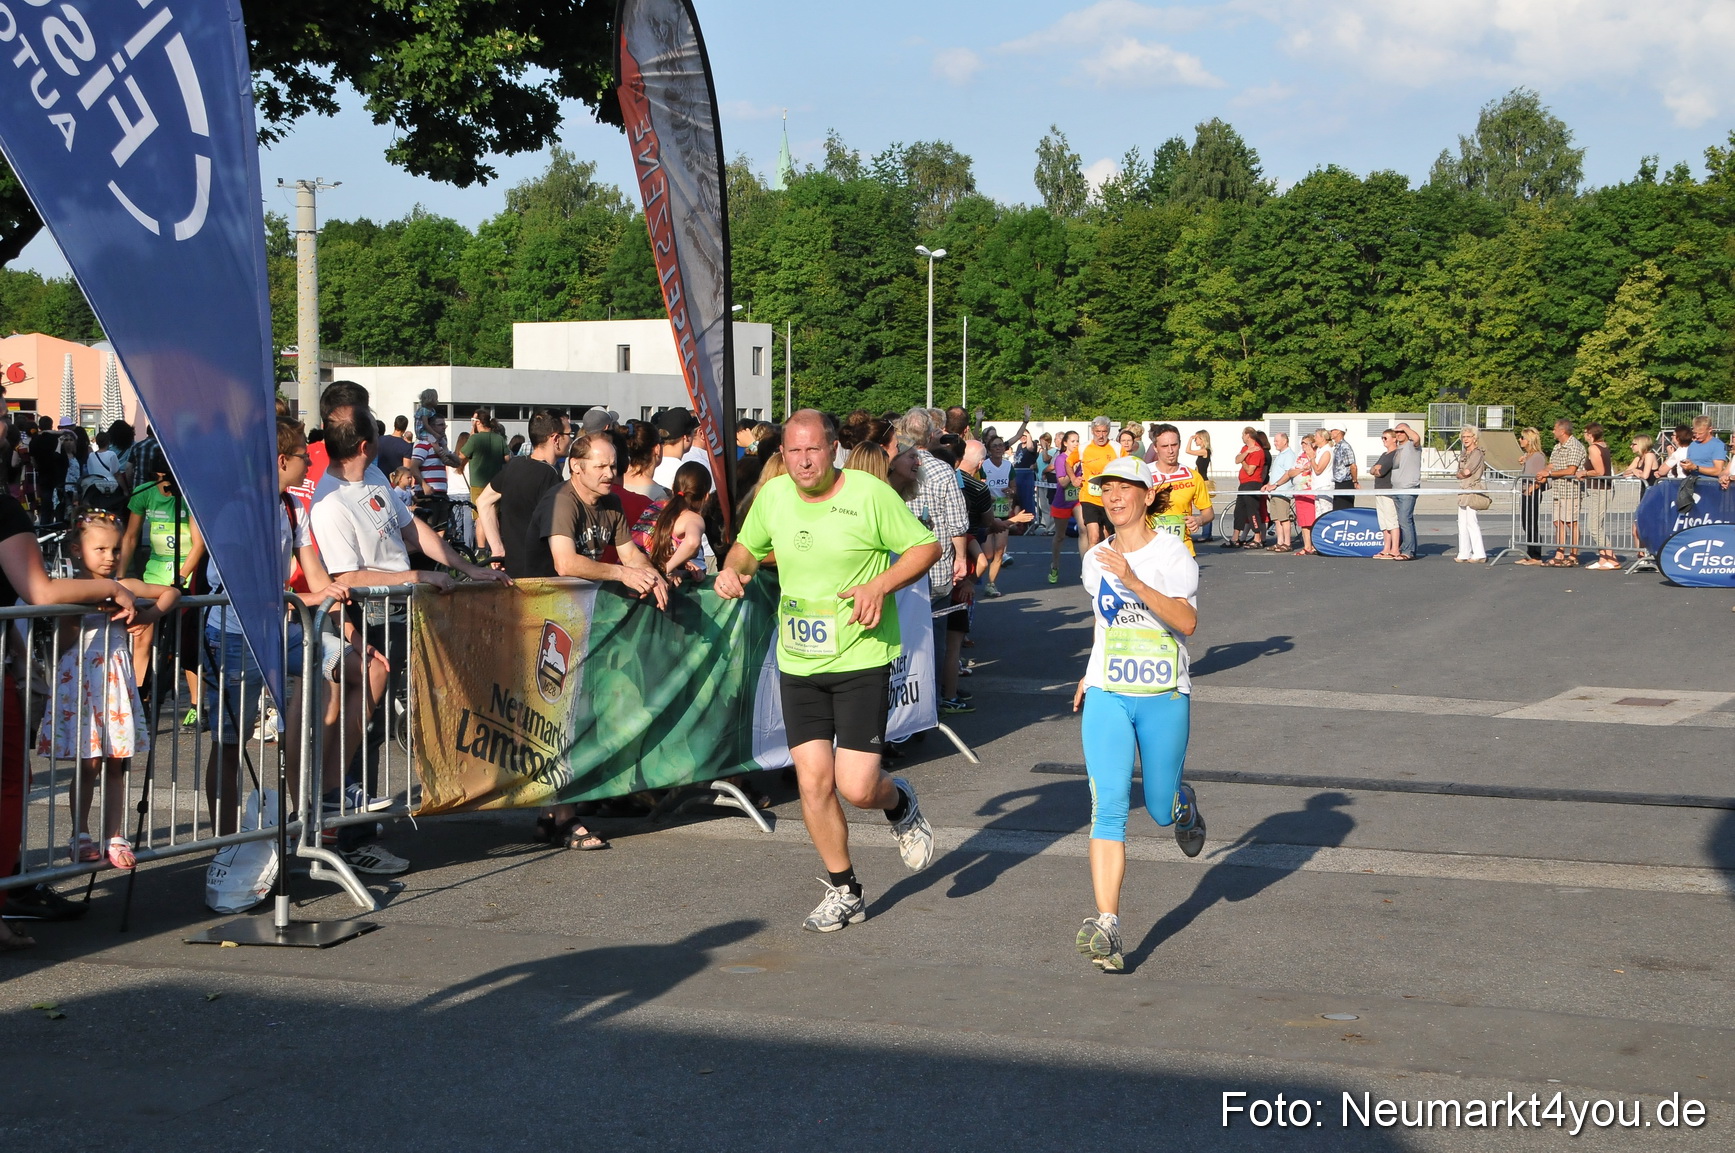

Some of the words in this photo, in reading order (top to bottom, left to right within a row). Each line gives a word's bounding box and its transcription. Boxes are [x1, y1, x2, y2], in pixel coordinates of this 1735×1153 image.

[838, 507, 858, 517] DEKRA
[1333, 528, 1384, 541] Fische
[1691, 552, 1735, 566] Fisc
[787, 617, 827, 644] 196
[1107, 658, 1172, 685] 5069
[543, 679, 557, 697] 1628
